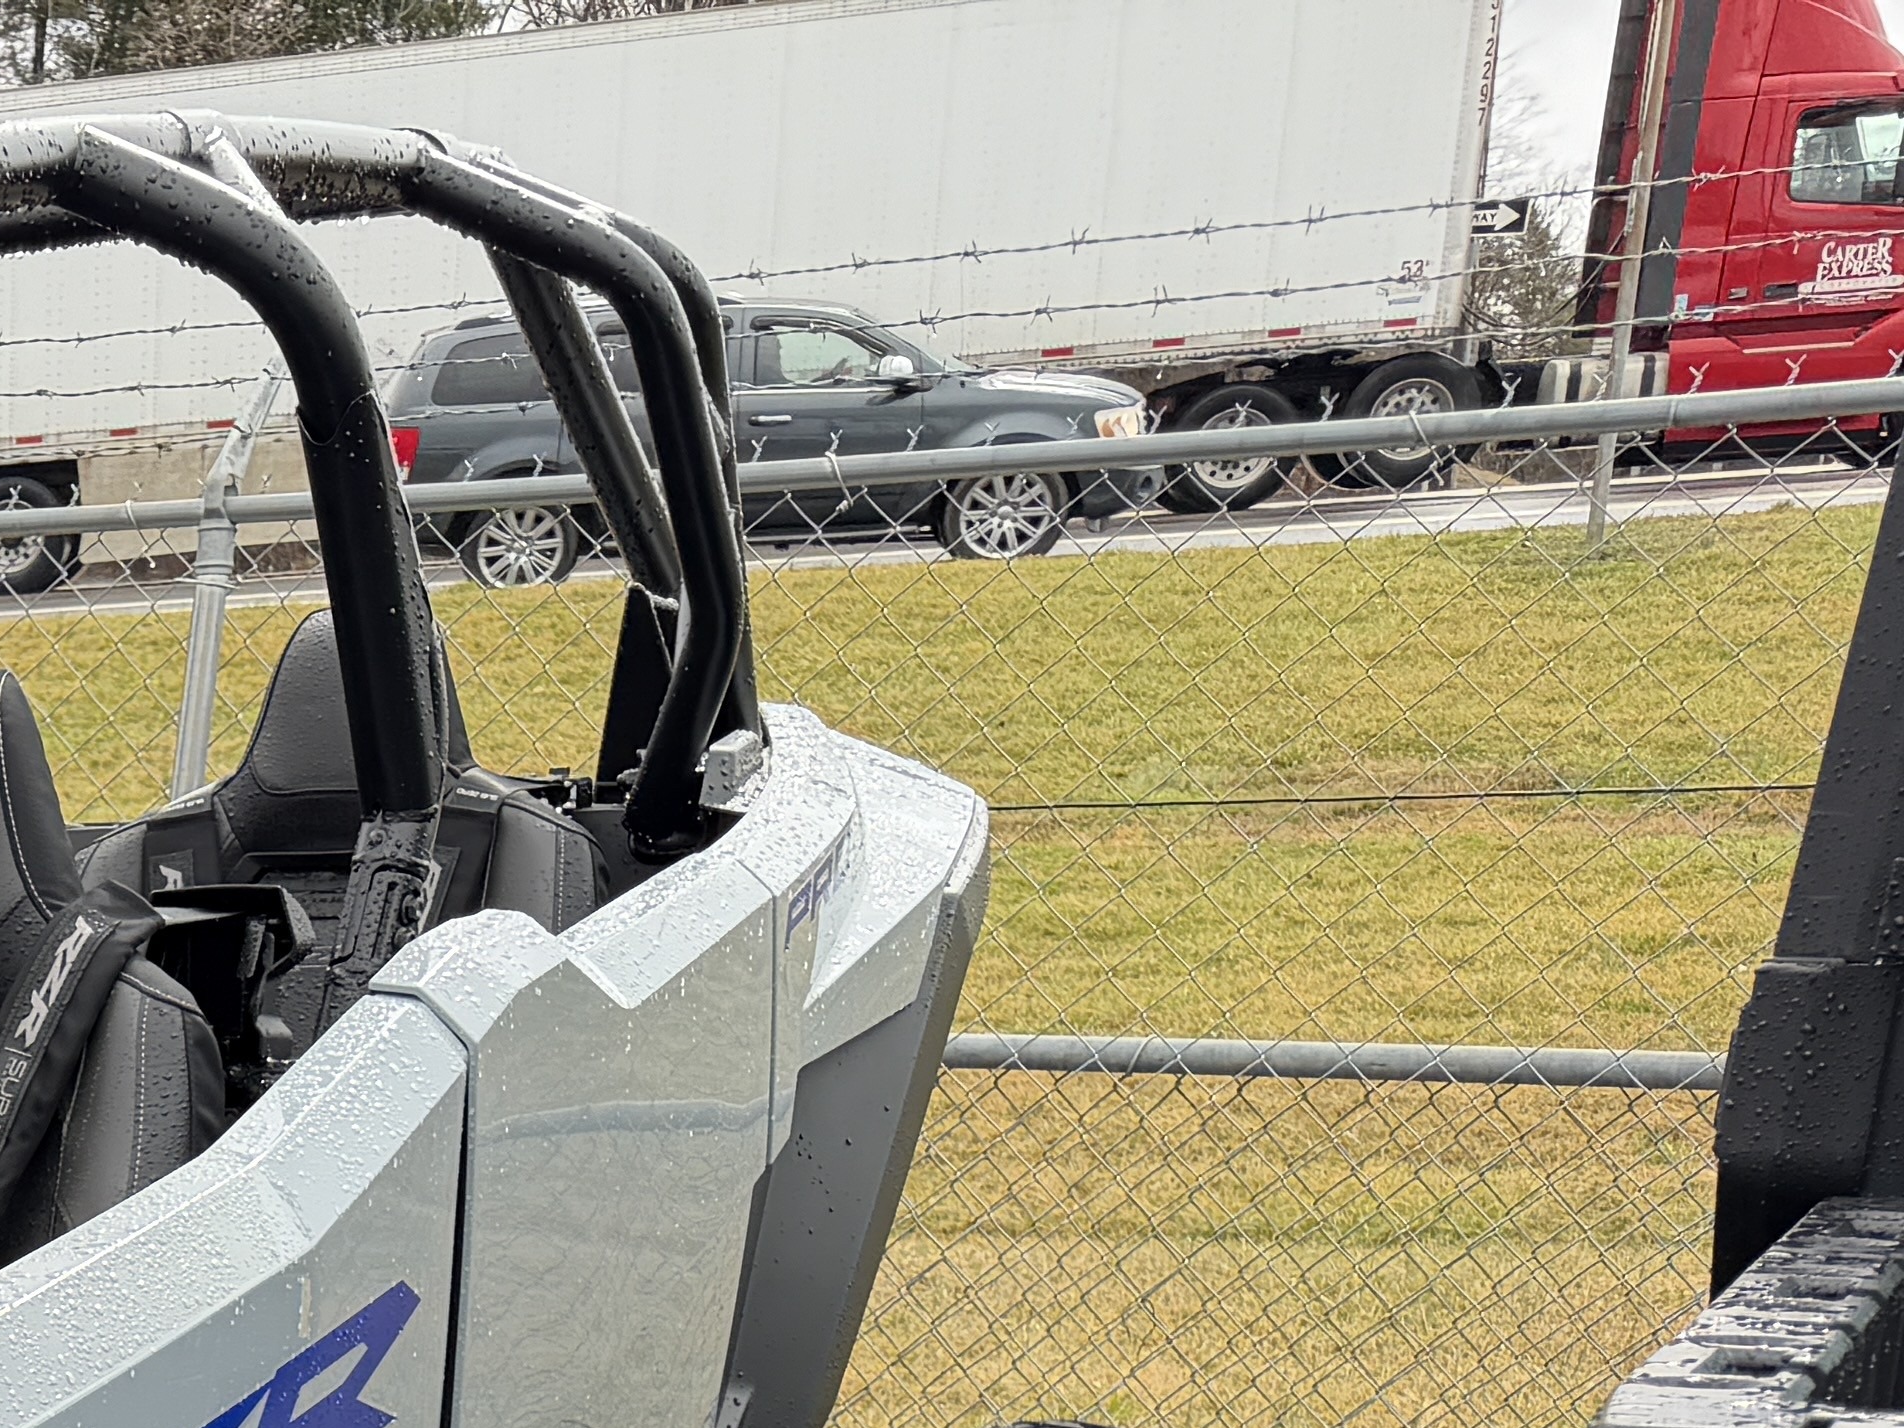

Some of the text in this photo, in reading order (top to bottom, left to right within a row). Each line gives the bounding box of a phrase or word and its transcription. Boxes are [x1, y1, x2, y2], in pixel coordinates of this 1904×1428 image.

[1821, 238, 1893, 263] CARTER
[1816, 259, 1893, 283] EXPRESS
[14, 915, 94, 1048] RZR
